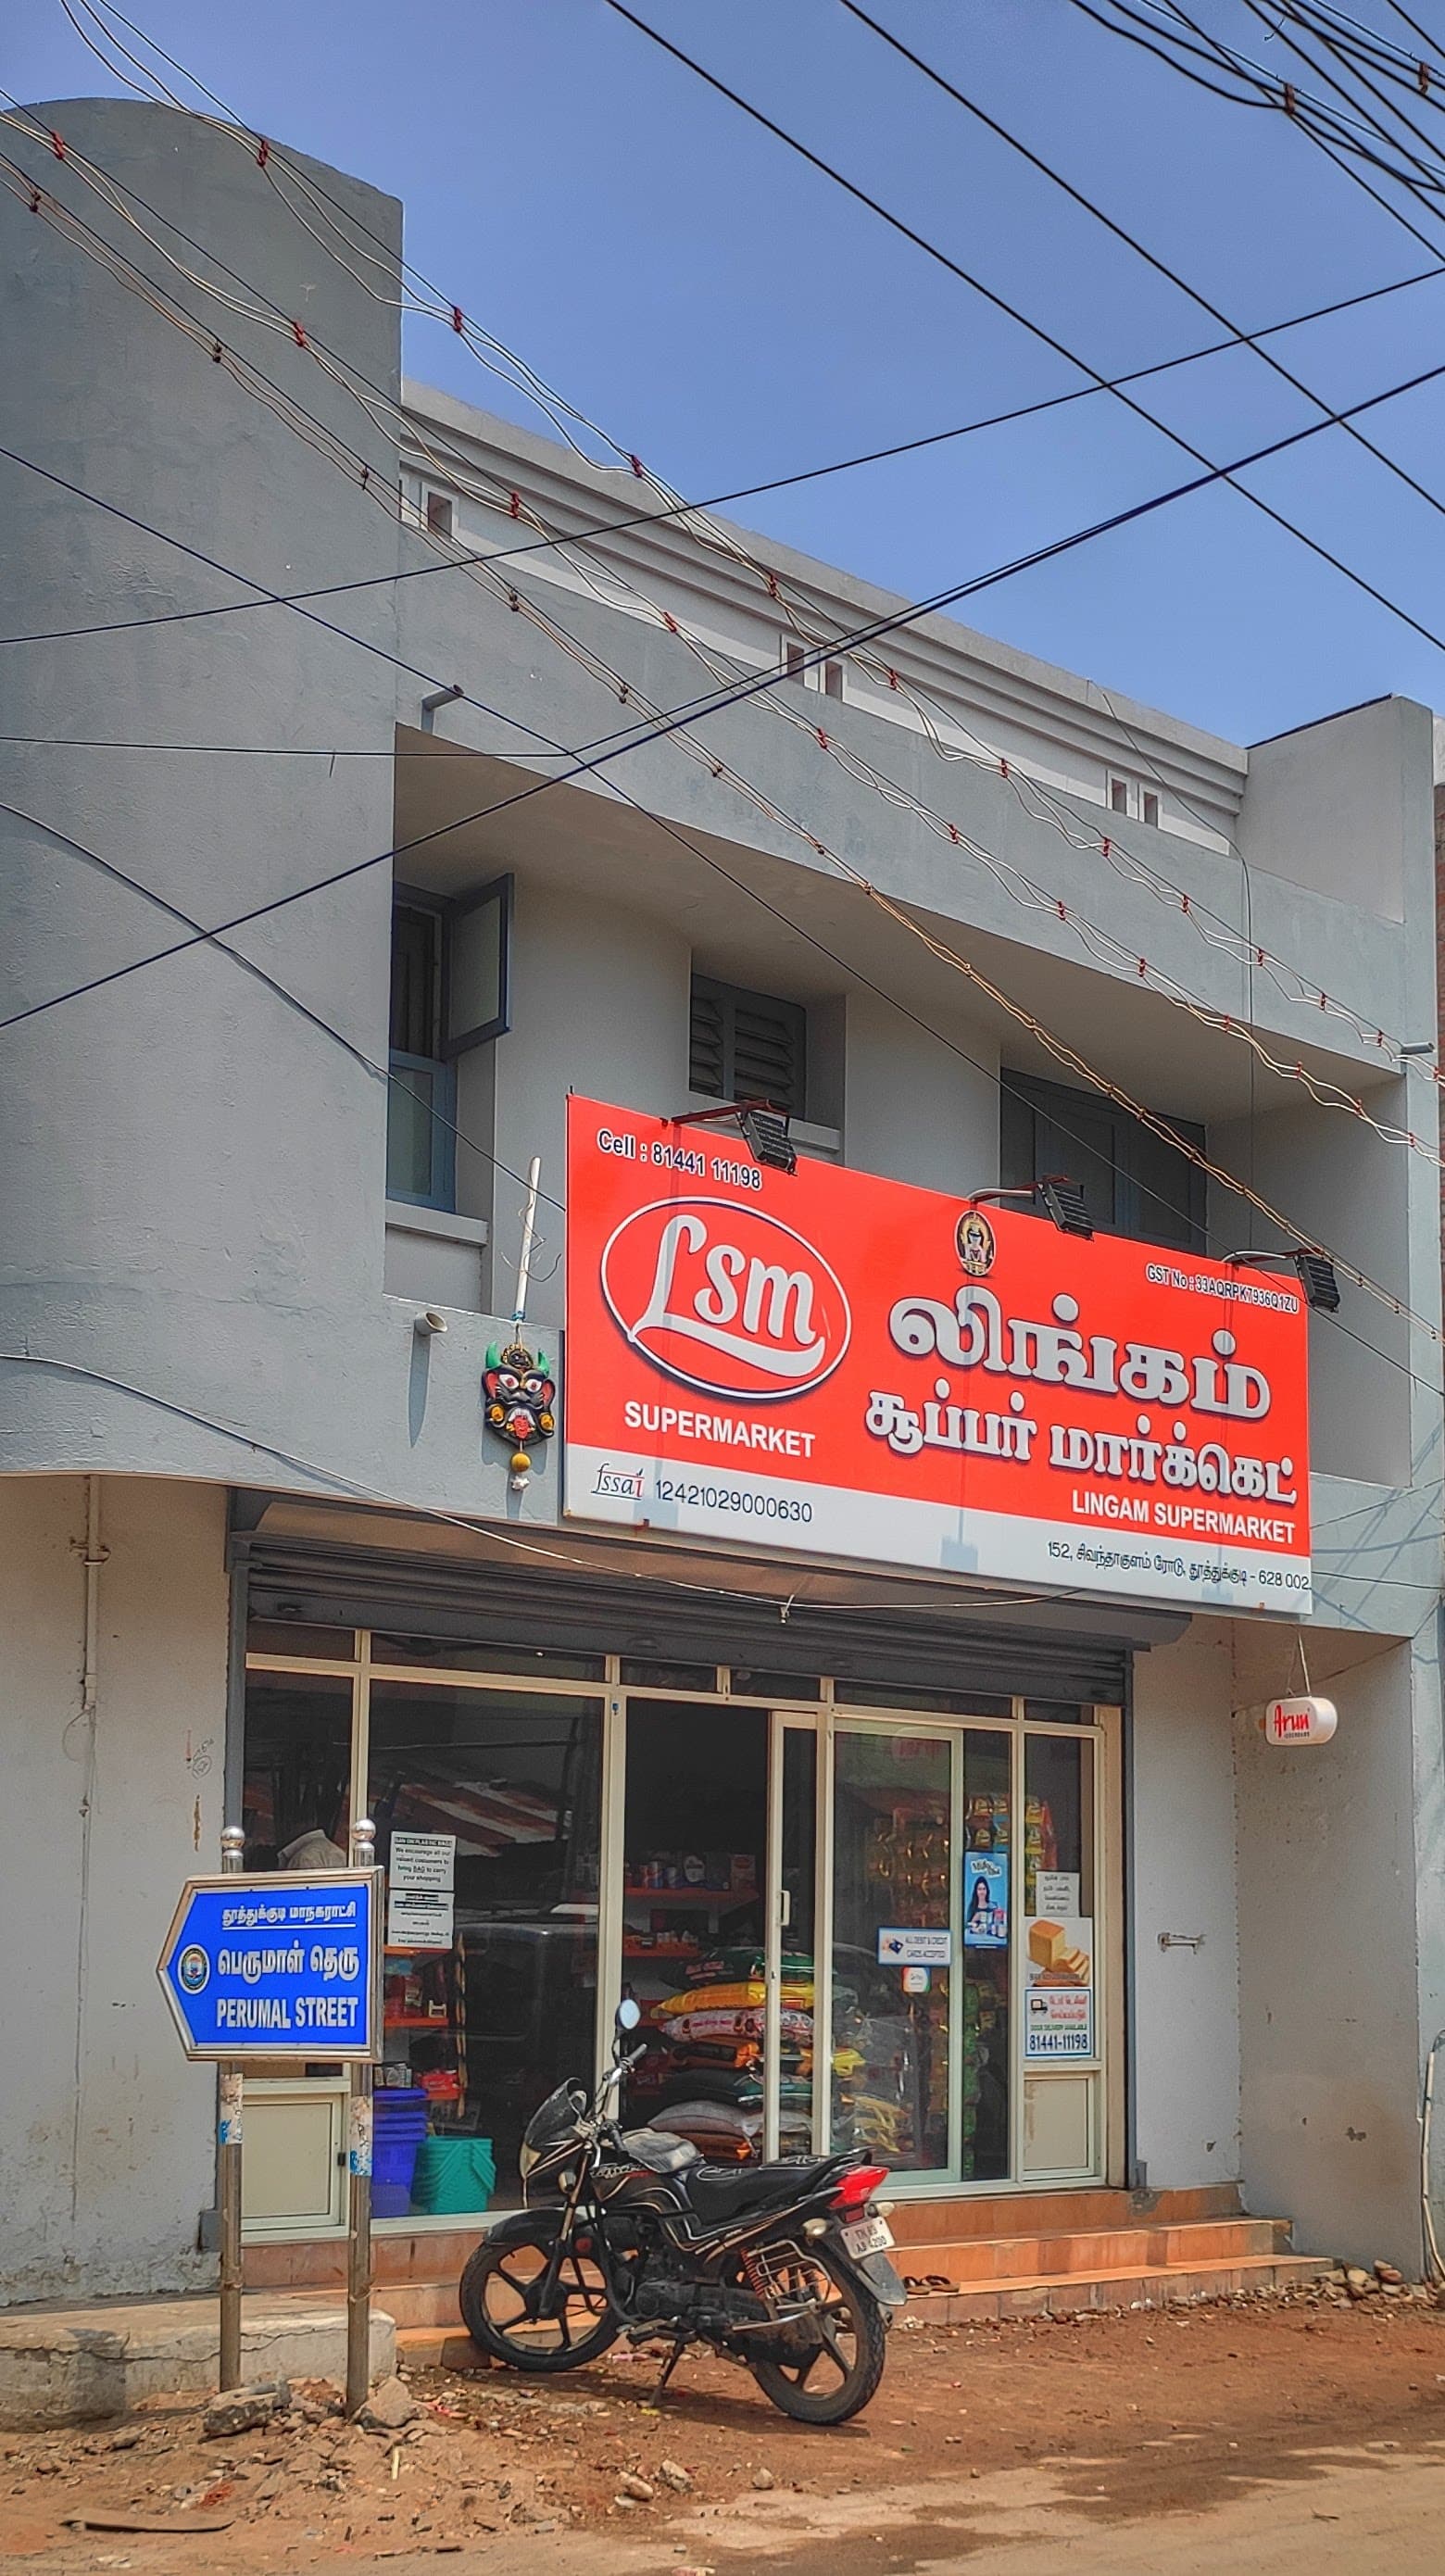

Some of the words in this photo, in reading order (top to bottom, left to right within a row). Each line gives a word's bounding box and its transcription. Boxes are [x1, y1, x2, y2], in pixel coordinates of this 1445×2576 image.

[598, 1129, 635, 1158] Cell
[652, 1142, 705, 1175] 81441
[711, 1159, 762, 1191] 11198
[1146, 1263, 1170, 1286] GST
[1171, 1270, 1187, 1289] No
[889, 1285, 1271, 1420] லிங்கம்
[624, 1401, 816, 1458] SUPERMARKET
[865, 1377, 1037, 1460] சூப்பர்
[1049, 1414, 1298, 1504] மார்க்கெட்
[591, 1463, 646, 1501] fssai
[656, 1478, 812, 1523] 12421029000630
[1072, 1489, 1150, 1524] LINGAM
[1154, 1502, 1295, 1545] SUPERMARKET
[1048, 1541, 1073, 1561] 152,
[1259, 1569, 1283, 1587] 628
[1274, 1704, 1310, 1738] Arun
[222, 1905, 286, 1927] தூத்துக்குடி
[290, 1901, 356, 1923] மாநகராட்சி
[218, 1939, 306, 1984] பெருமாள்
[310, 1944, 359, 1981] தெரு
[217, 1998, 292, 2029] PERUMAL
[295, 1996, 359, 2028] STREET
[1029, 2033, 1088, 2051] 81441-11198
